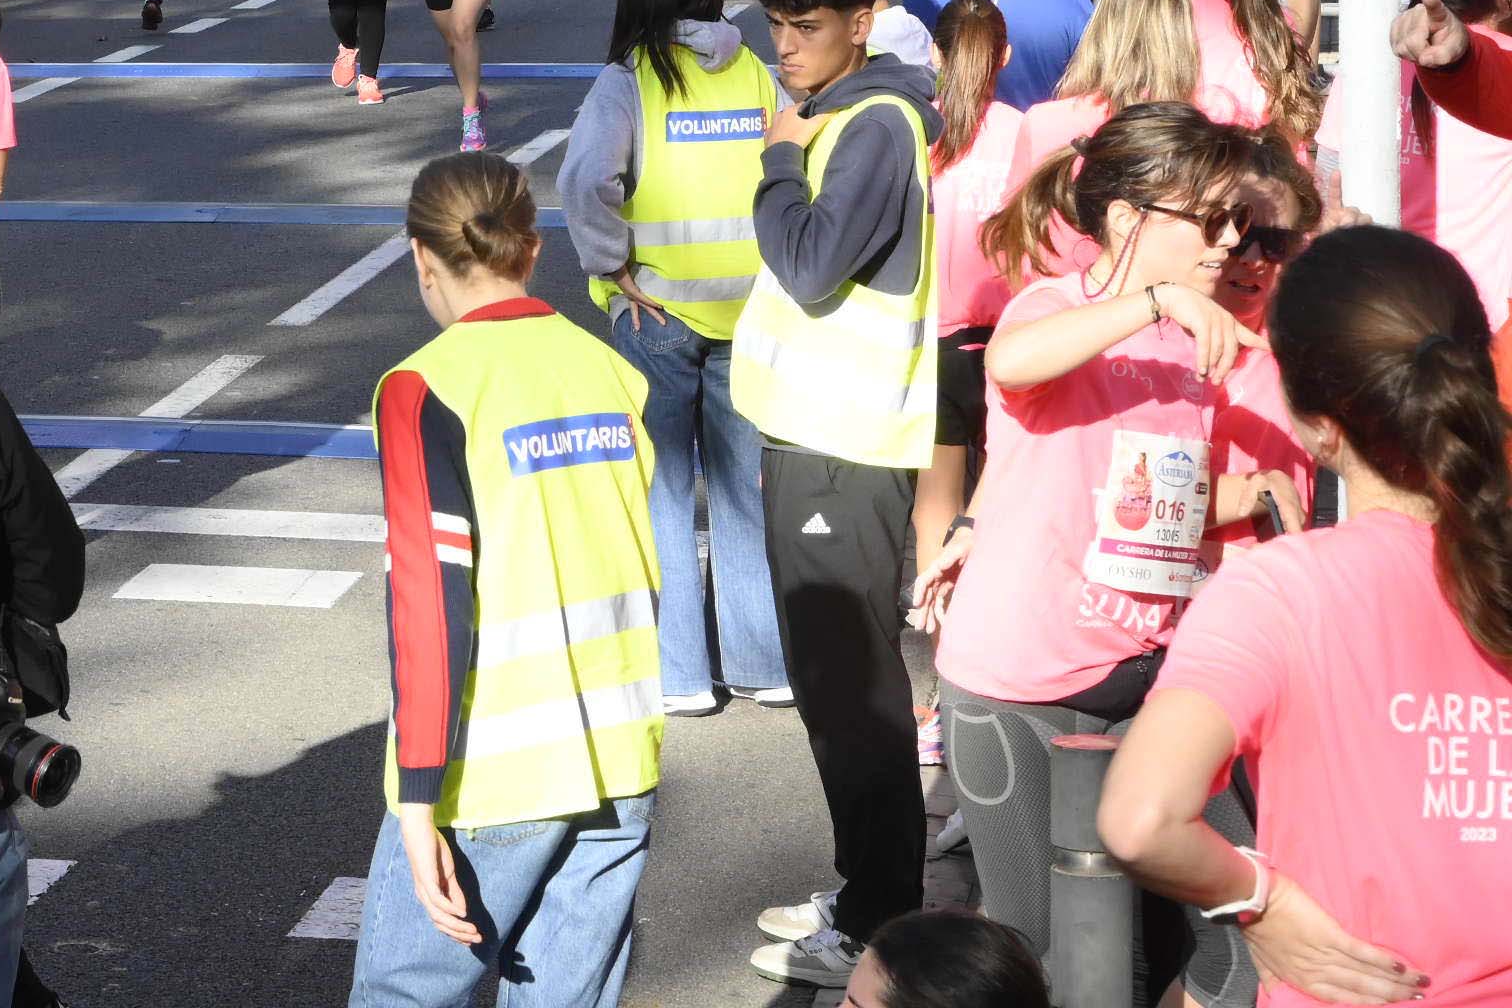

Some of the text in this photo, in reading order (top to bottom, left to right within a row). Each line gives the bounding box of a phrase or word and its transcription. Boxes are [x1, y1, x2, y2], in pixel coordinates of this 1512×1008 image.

[668, 116, 762, 135] VOLUNTARIS
[509, 426, 631, 463] VOLUNTARIS
[1155, 498, 1185, 523] 016
[1427, 736, 1512, 777] DE L
[1459, 826, 1497, 842] 2023
